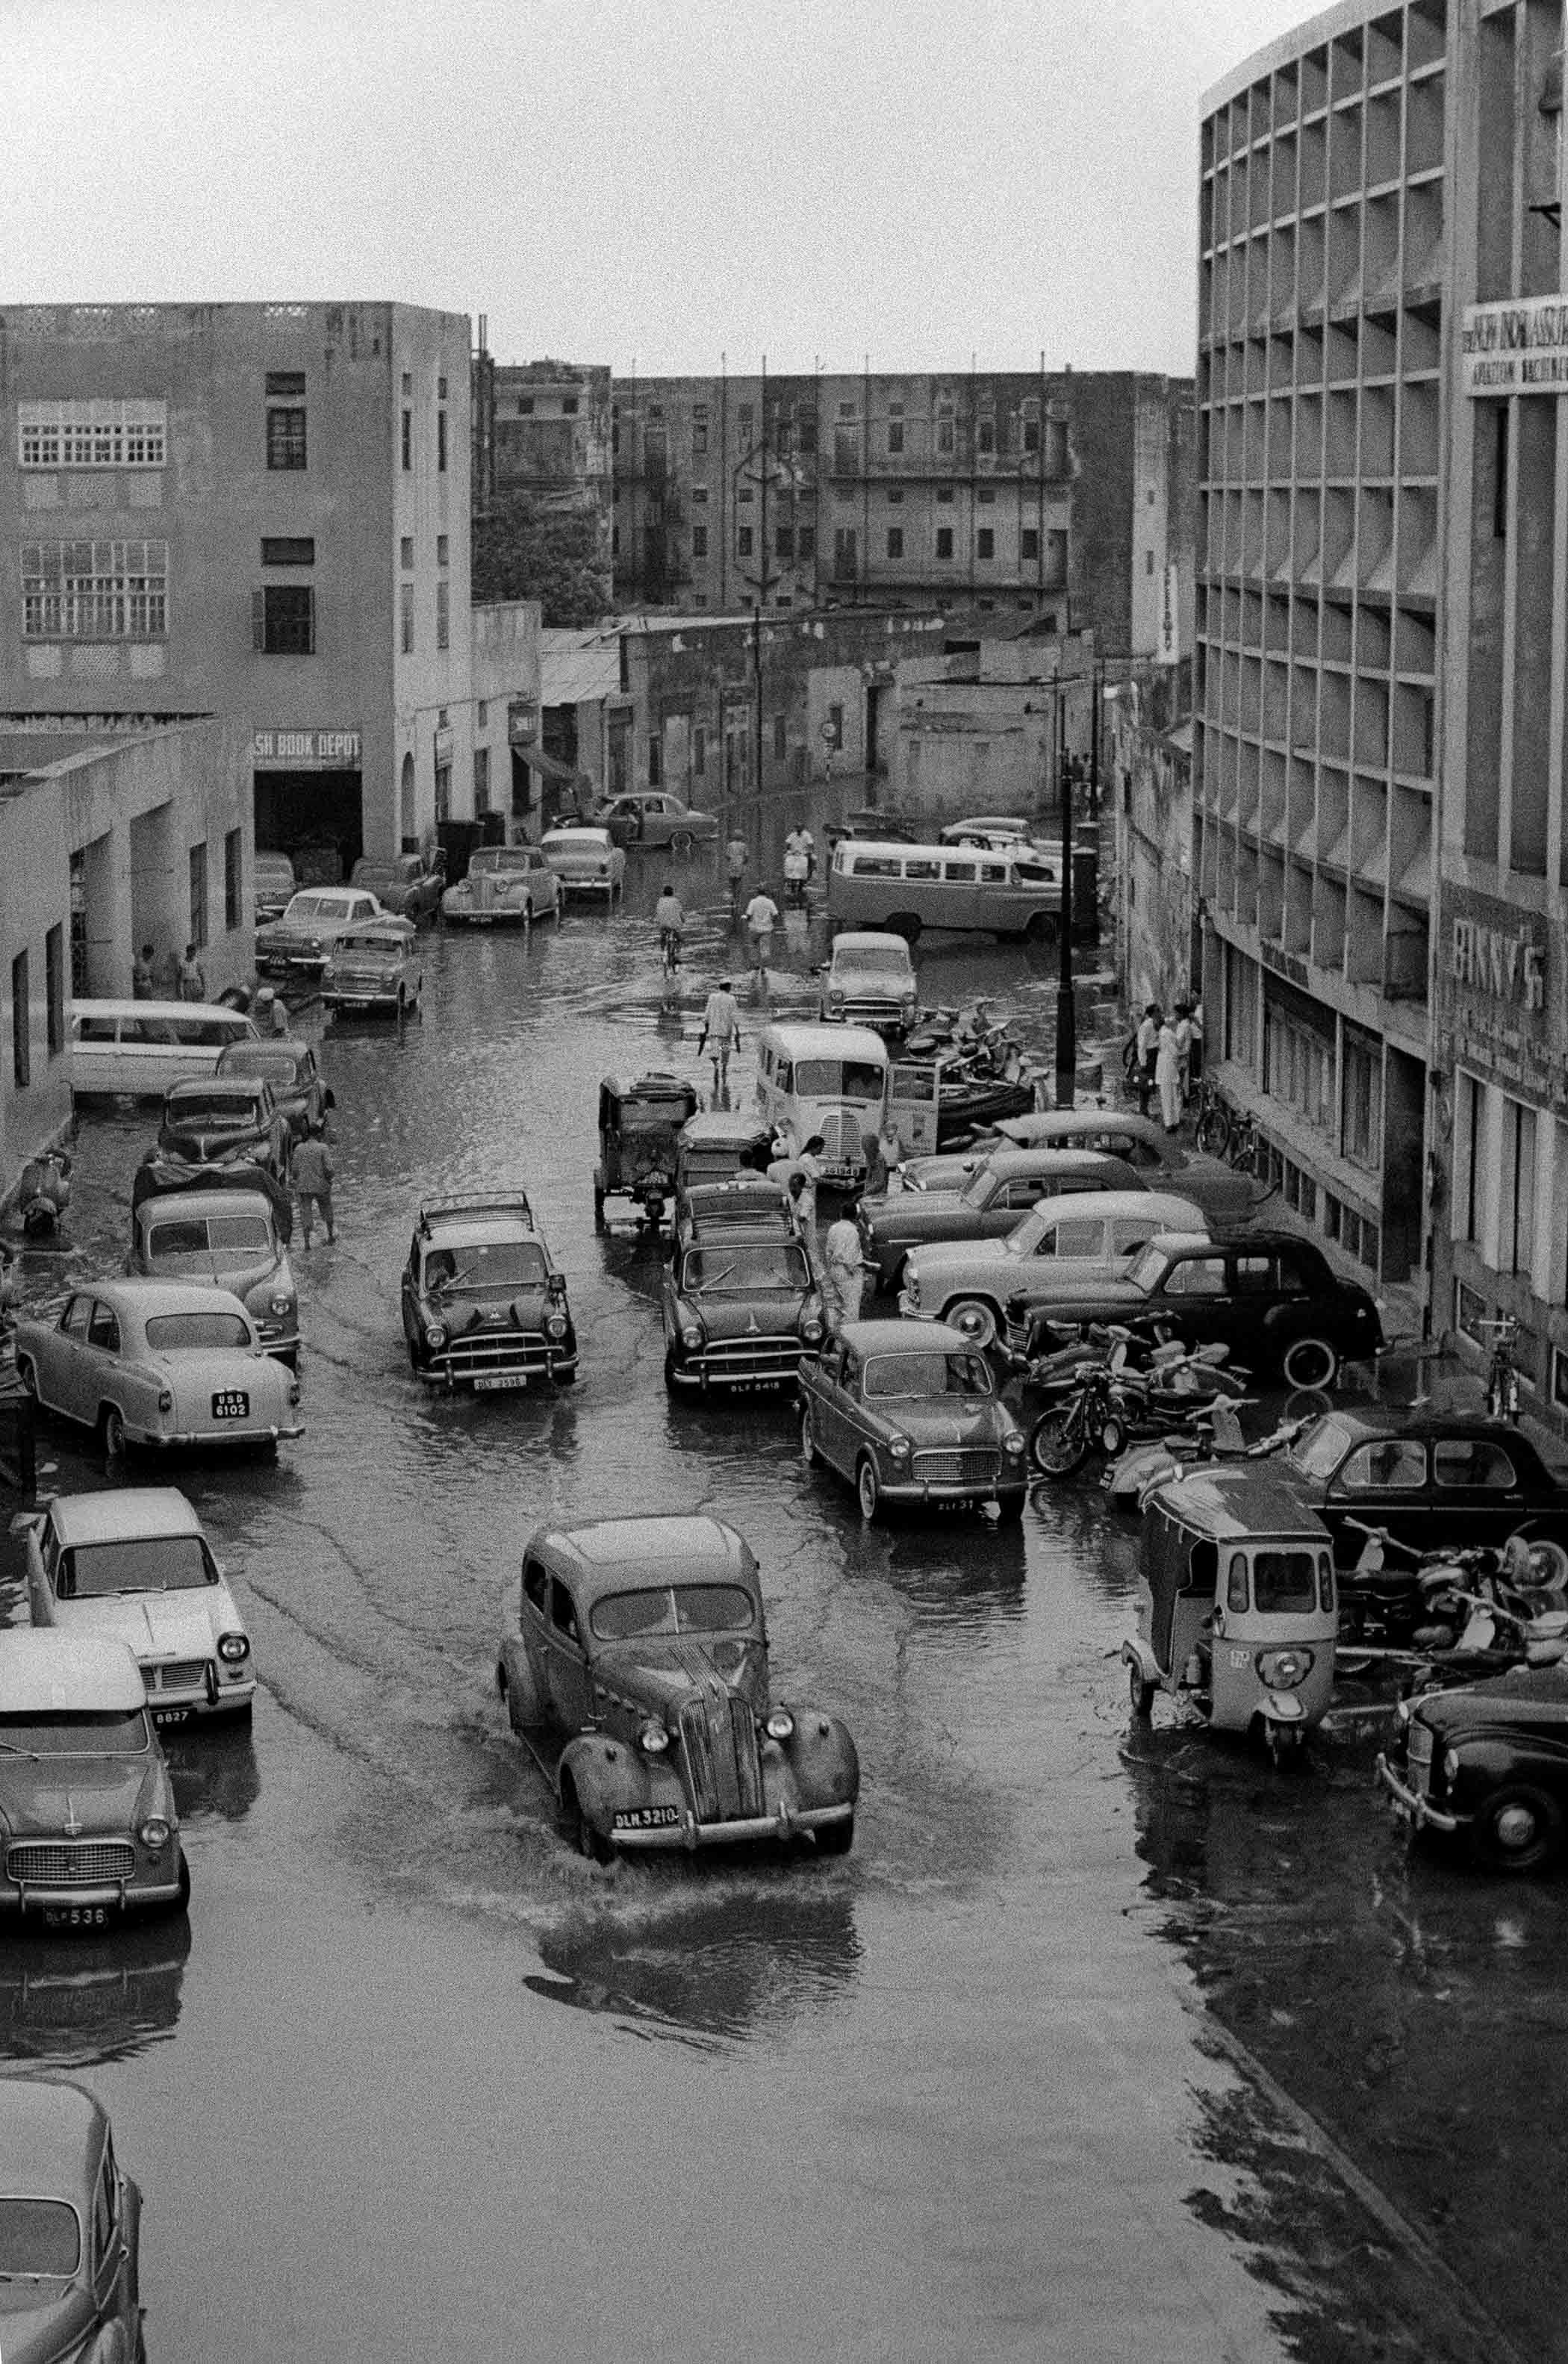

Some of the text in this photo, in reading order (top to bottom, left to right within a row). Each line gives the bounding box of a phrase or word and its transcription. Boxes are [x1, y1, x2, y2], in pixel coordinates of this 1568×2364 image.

[277, 734, 313, 756] BOOK
[318, 734, 360, 756] DEPOT
[219, 1394, 243, 1405] USD
[217, 1404, 246, 1416] 6102
